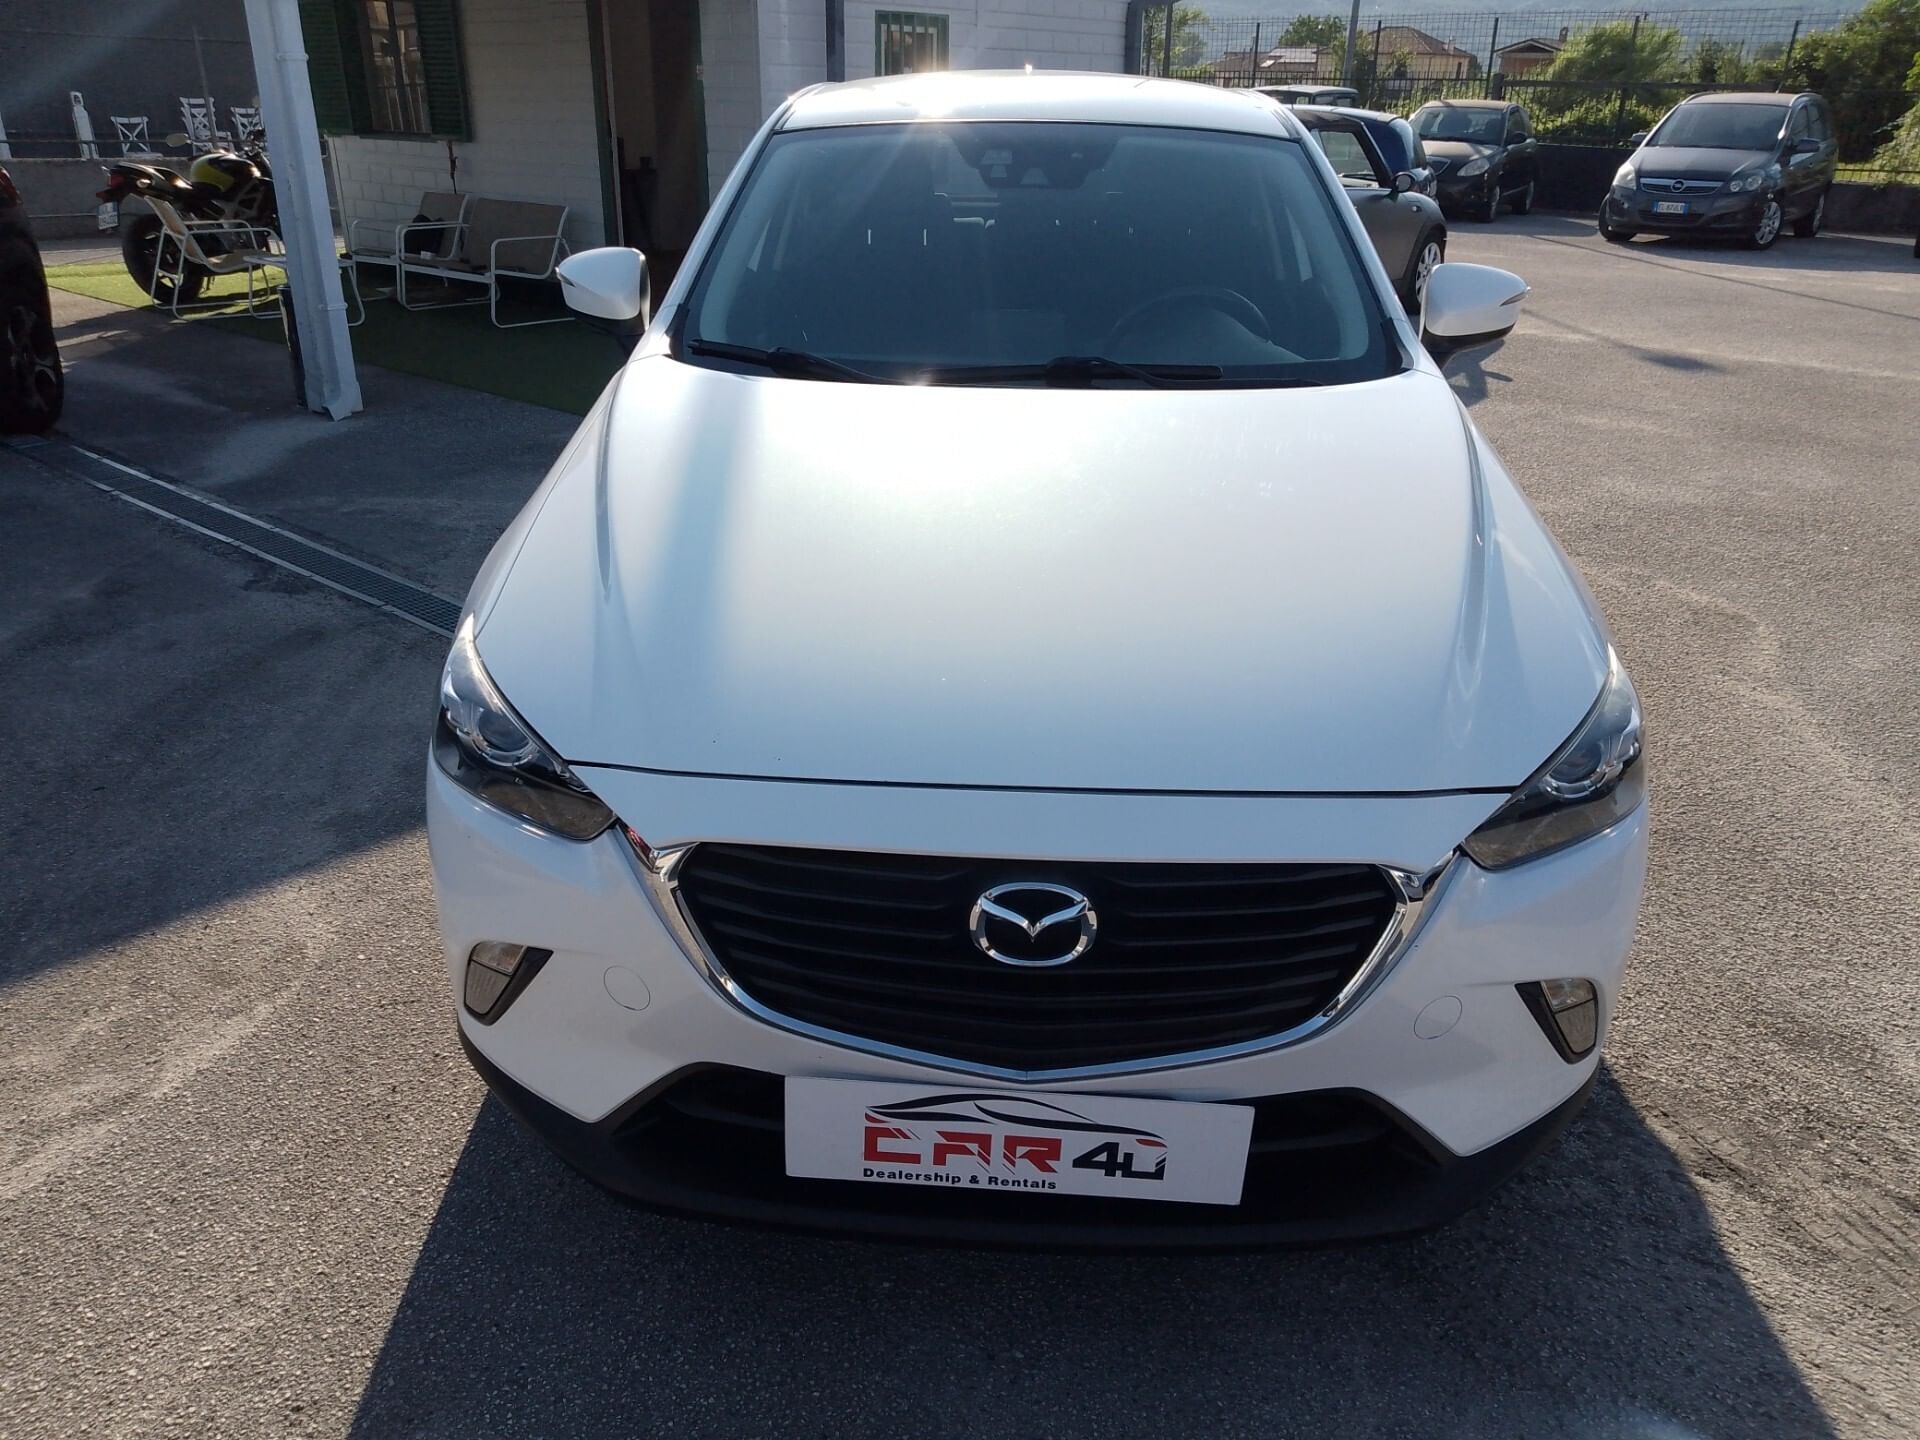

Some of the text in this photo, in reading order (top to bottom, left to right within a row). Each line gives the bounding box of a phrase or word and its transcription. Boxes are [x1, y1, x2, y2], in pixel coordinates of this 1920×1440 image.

[863, 1126, 1062, 1174] CAR
[863, 1167, 1057, 1190] Dealership & Rentals
